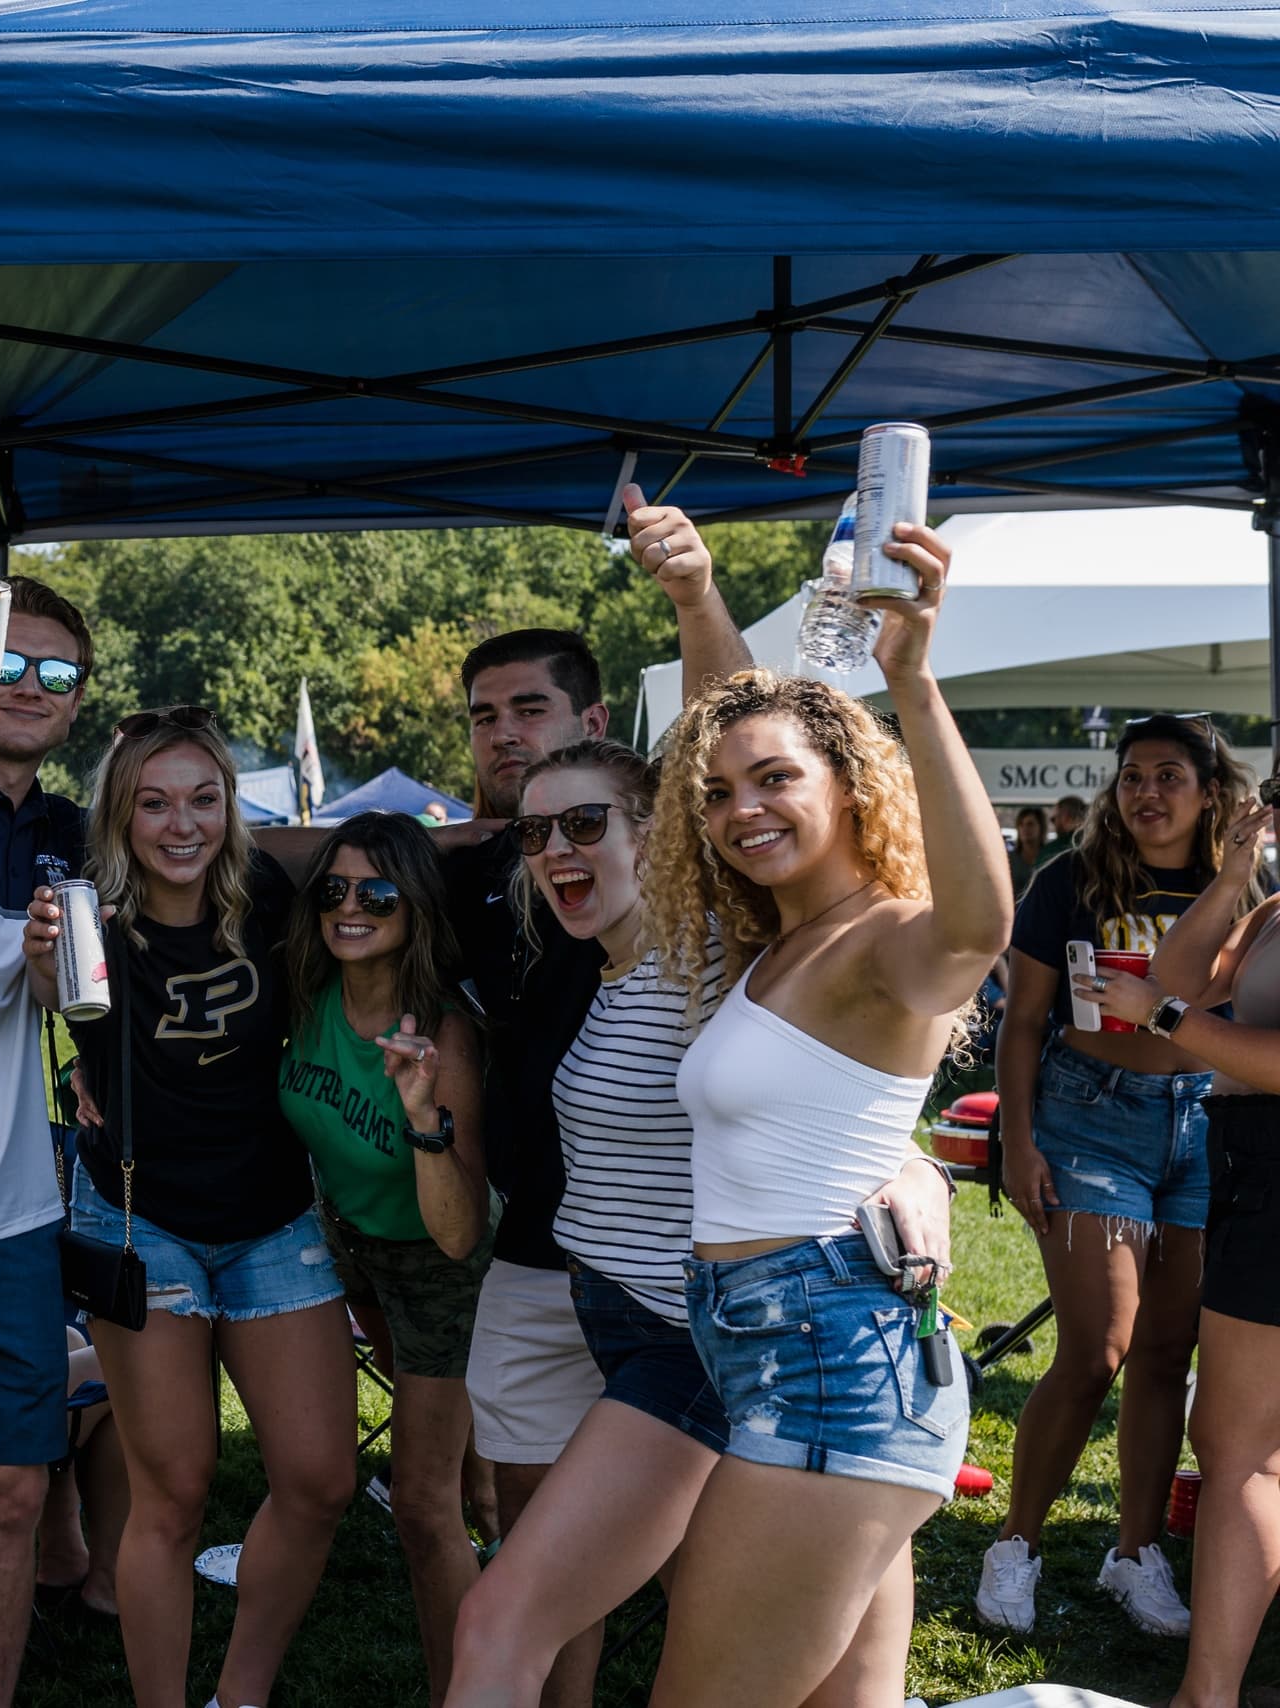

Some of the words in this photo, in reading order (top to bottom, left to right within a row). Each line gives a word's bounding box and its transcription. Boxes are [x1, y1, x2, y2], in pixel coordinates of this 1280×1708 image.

[1000, 764, 1058, 789] SMC
[1065, 764, 1106, 788] Chi
[154, 957, 259, 1039] P
[280, 1059, 343, 1109] NOTRE
[342, 1087, 397, 1158] DAME
